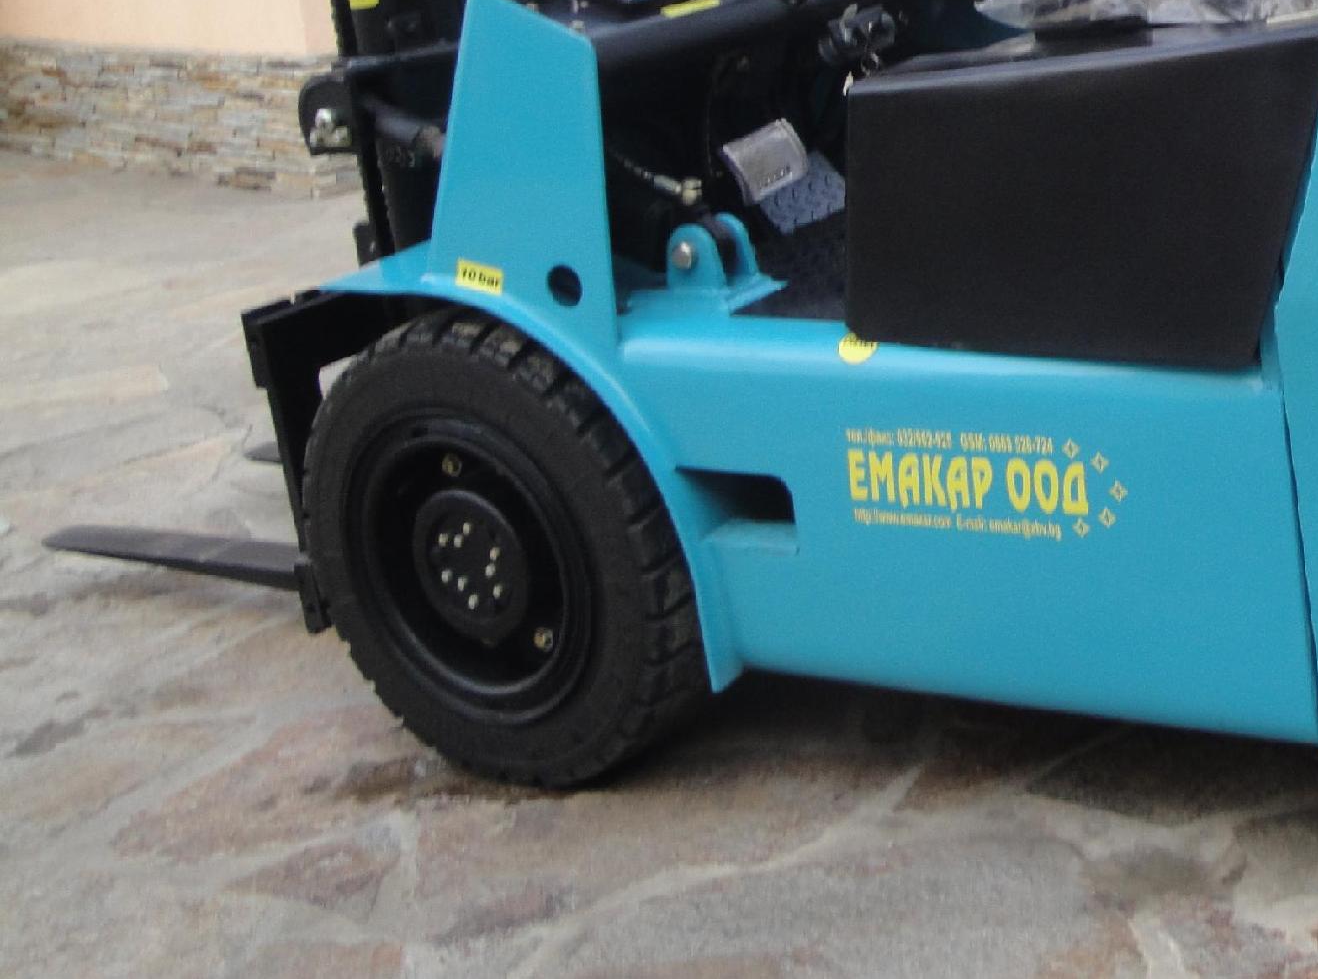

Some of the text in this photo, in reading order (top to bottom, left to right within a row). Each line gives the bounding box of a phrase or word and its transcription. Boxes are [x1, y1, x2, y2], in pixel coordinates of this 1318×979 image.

[479, 272, 499, 287] bar
[847, 448, 1089, 516] ЕМАКАР ООД
